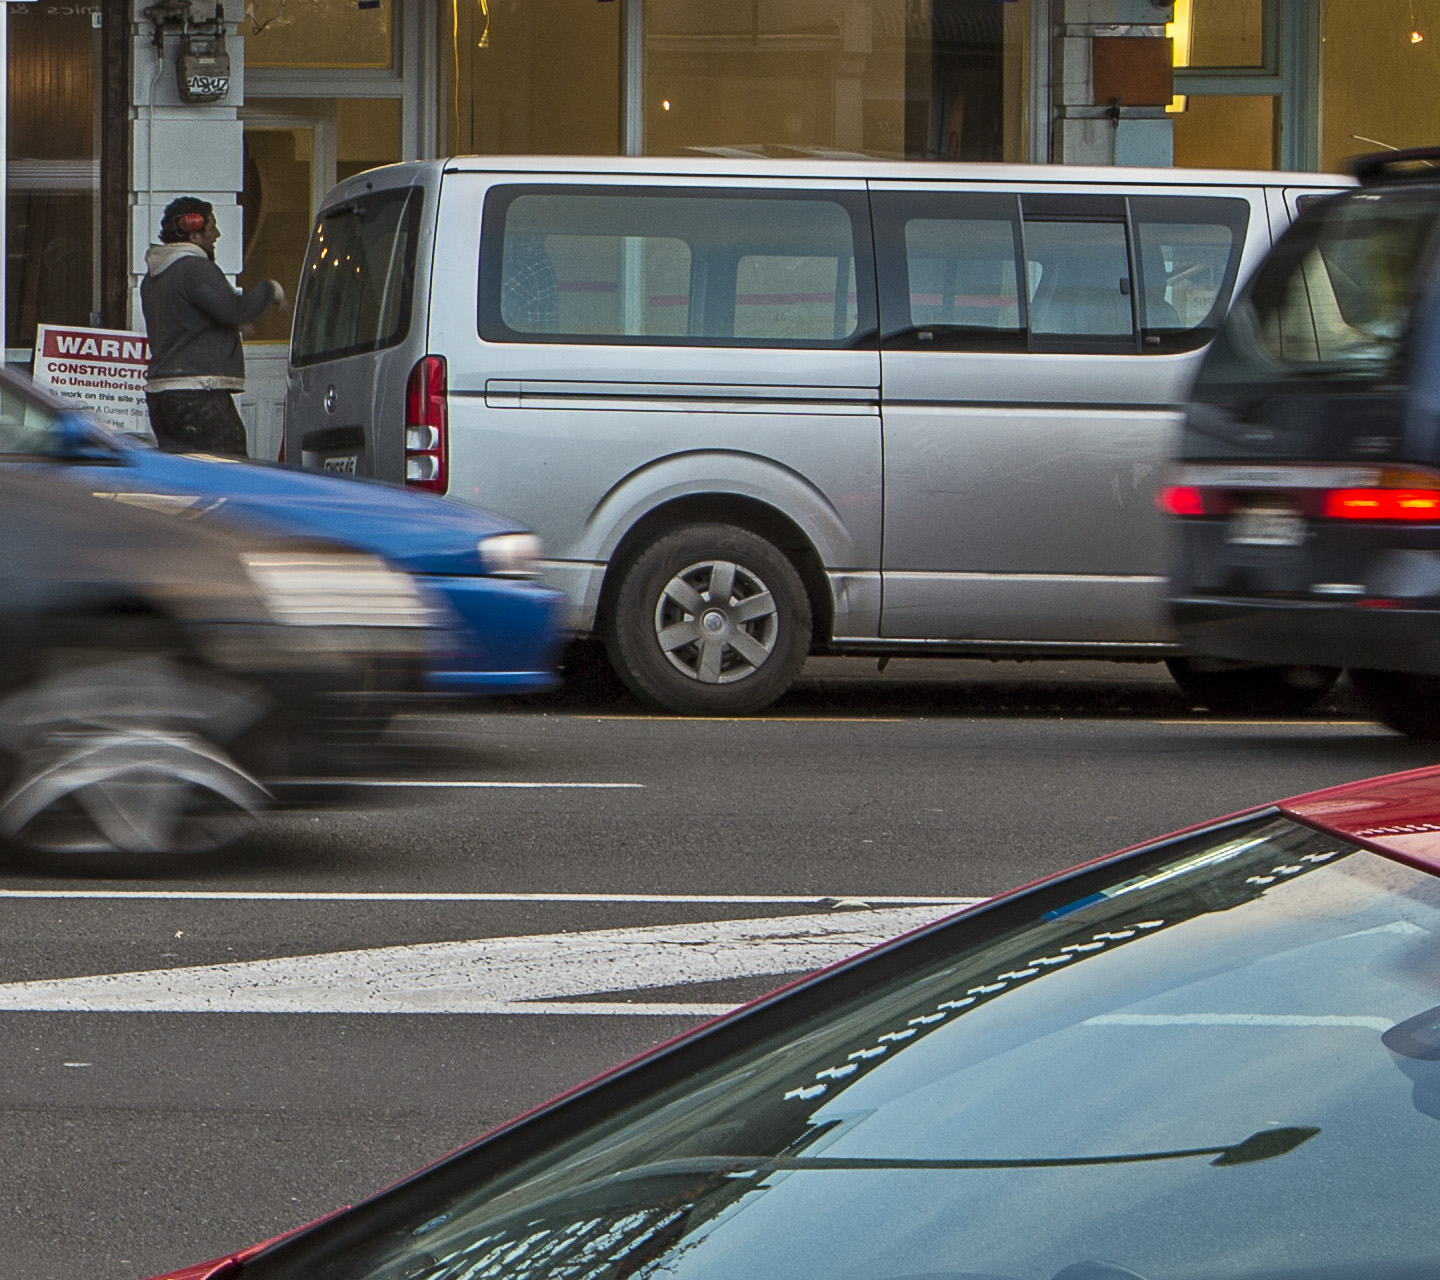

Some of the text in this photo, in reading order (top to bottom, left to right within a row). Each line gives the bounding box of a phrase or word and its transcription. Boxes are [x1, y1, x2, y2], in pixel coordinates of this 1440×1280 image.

[51, 376, 66, 385] No
[61, 390, 82, 399] work
[98, 391, 115, 401] this
[117, 392, 133, 402] site
[136, 396, 147, 405] yo
[103, 406, 128, 415] Current
